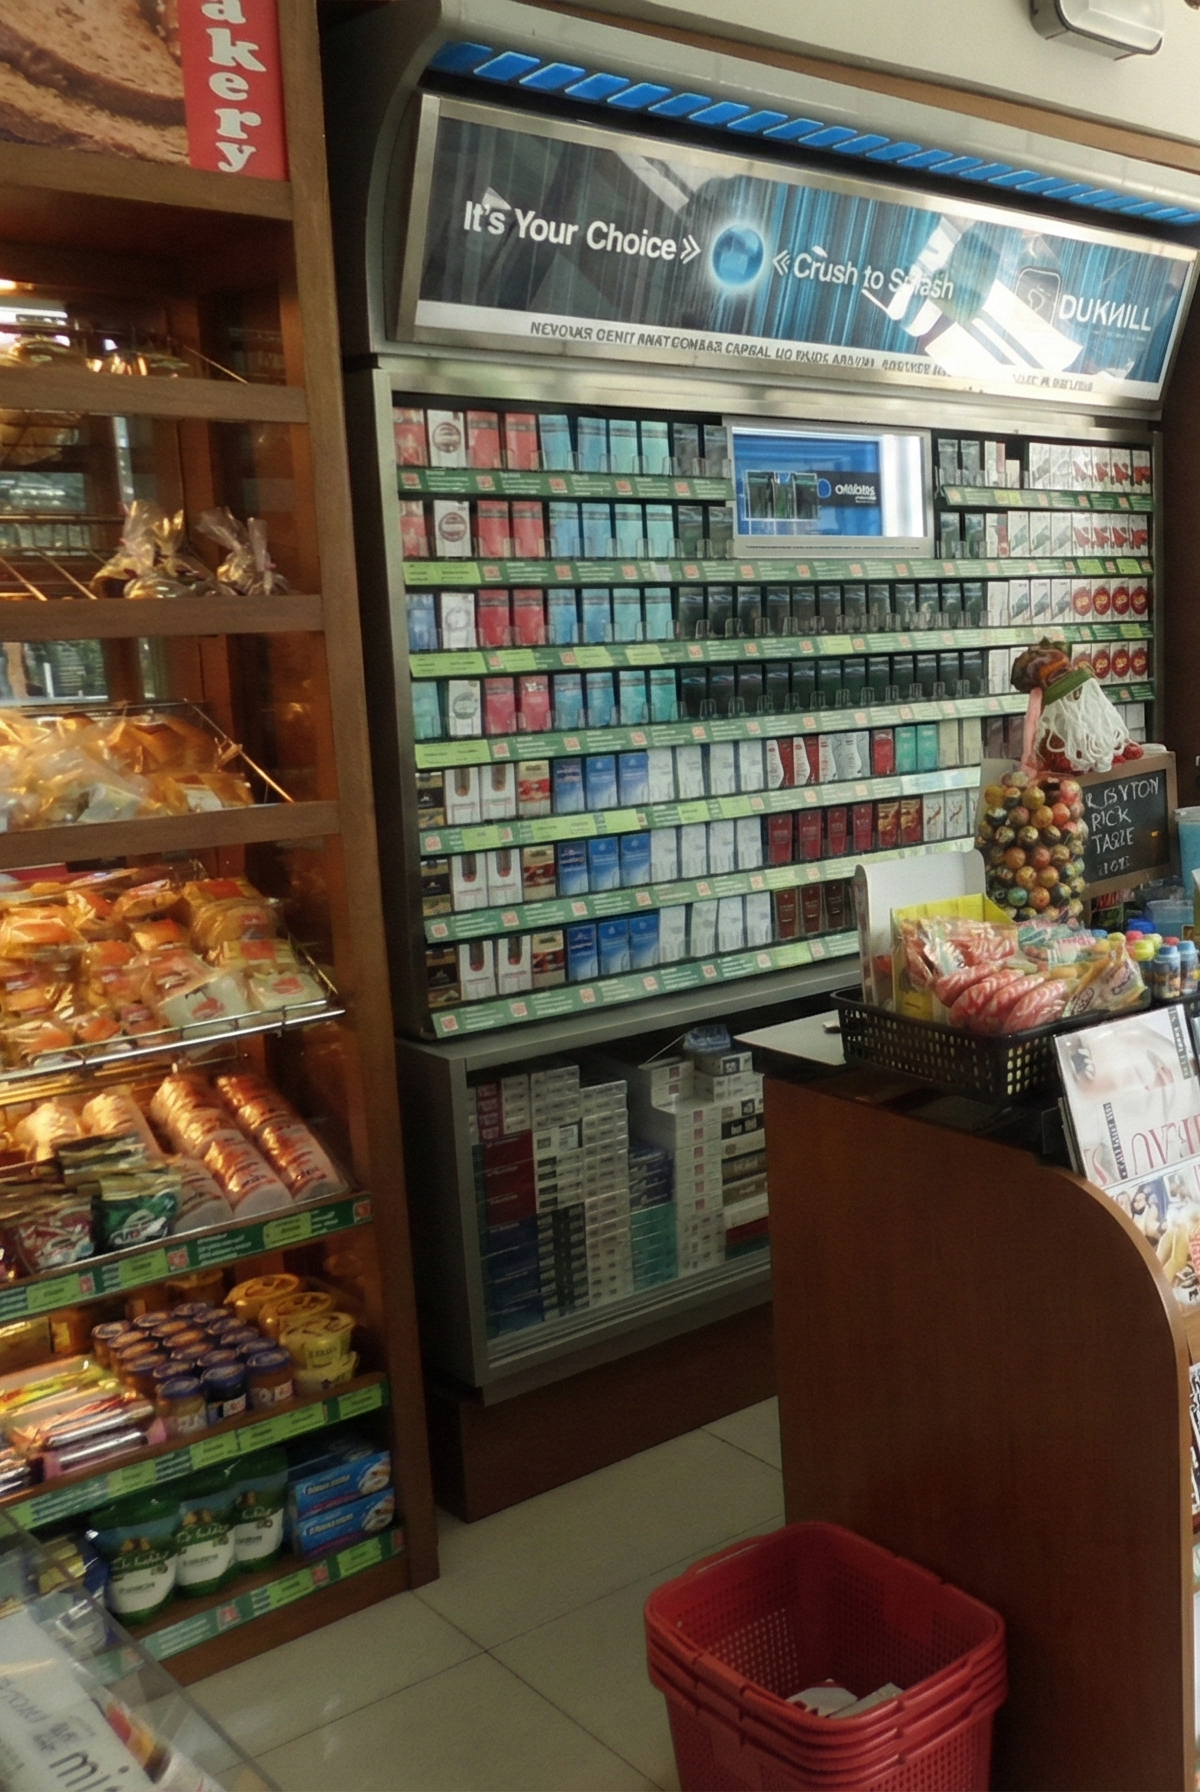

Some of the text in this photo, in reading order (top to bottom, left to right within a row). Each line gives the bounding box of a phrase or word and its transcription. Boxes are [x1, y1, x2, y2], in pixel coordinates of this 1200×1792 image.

[464, 200, 677, 260] It's Your Choice
[793, 253, 954, 300] Crush to Slash
